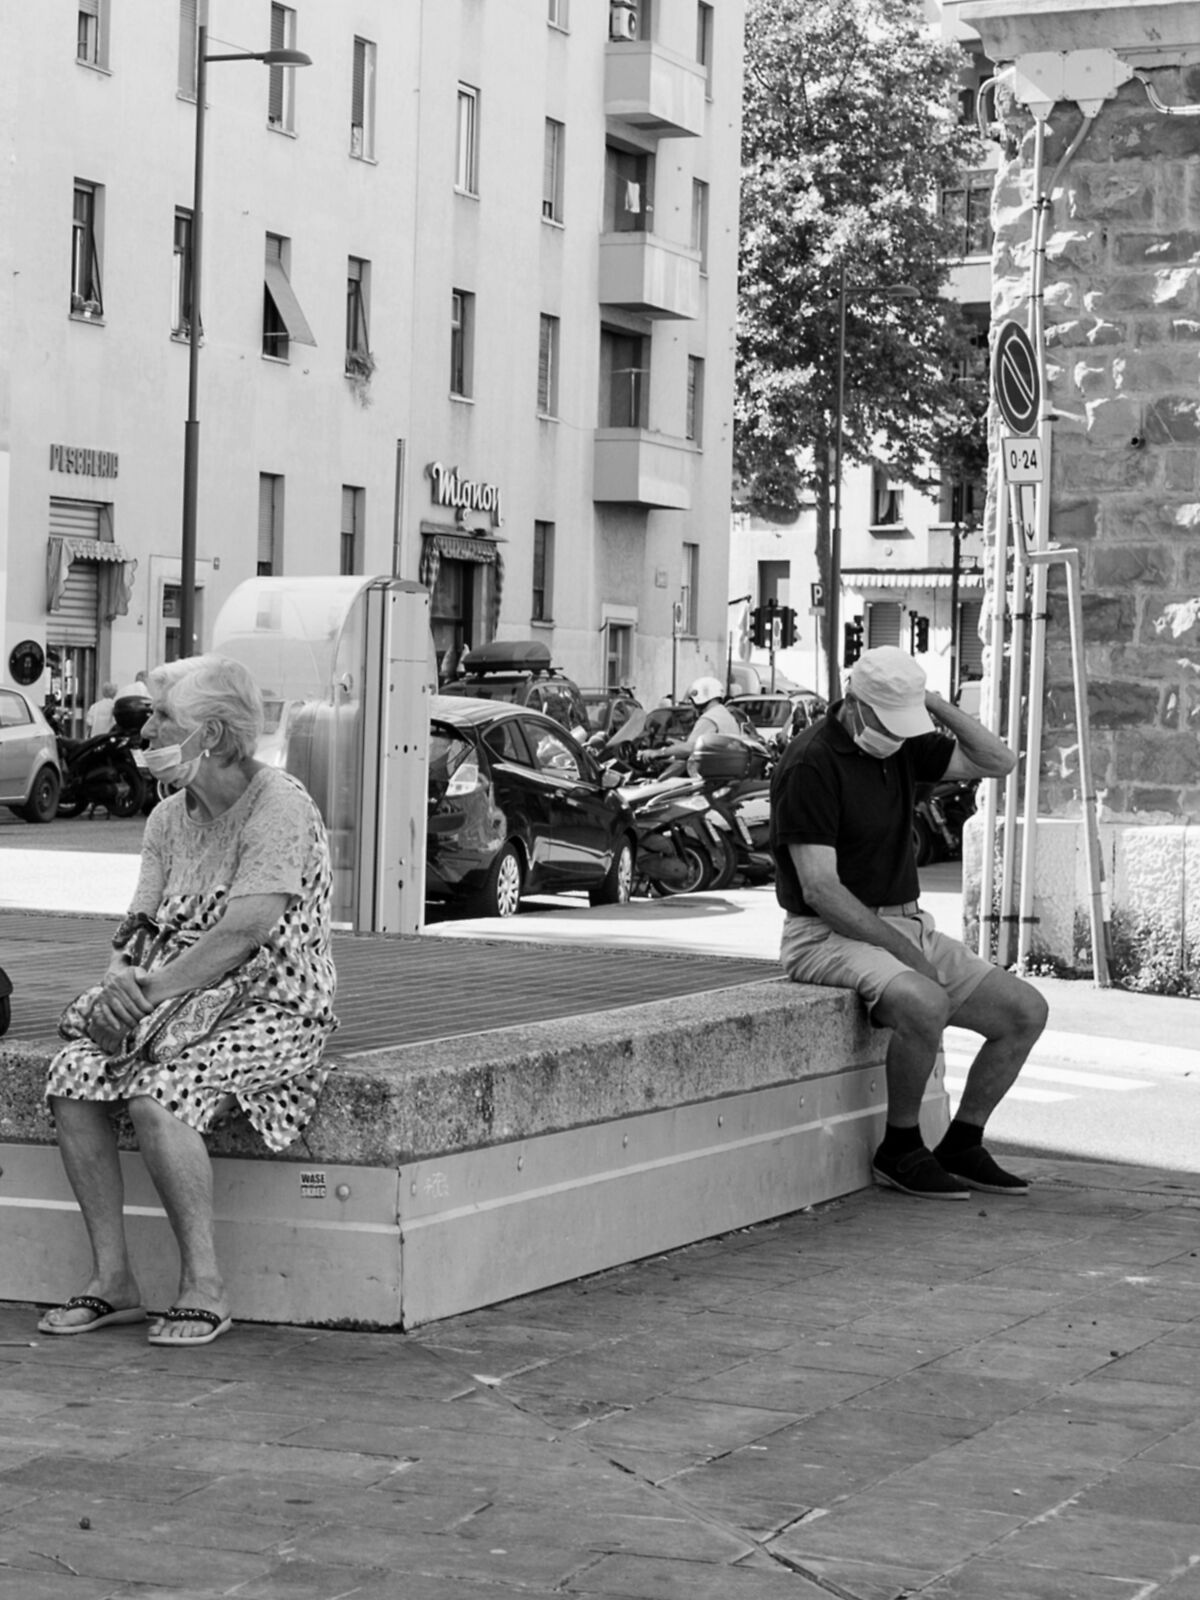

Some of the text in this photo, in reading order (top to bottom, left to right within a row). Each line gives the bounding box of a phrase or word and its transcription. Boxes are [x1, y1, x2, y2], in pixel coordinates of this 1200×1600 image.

[49, 443, 119, 479] PESCHERIA
[427, 461, 504, 528] Mignon
[813, 584, 823, 605] P
